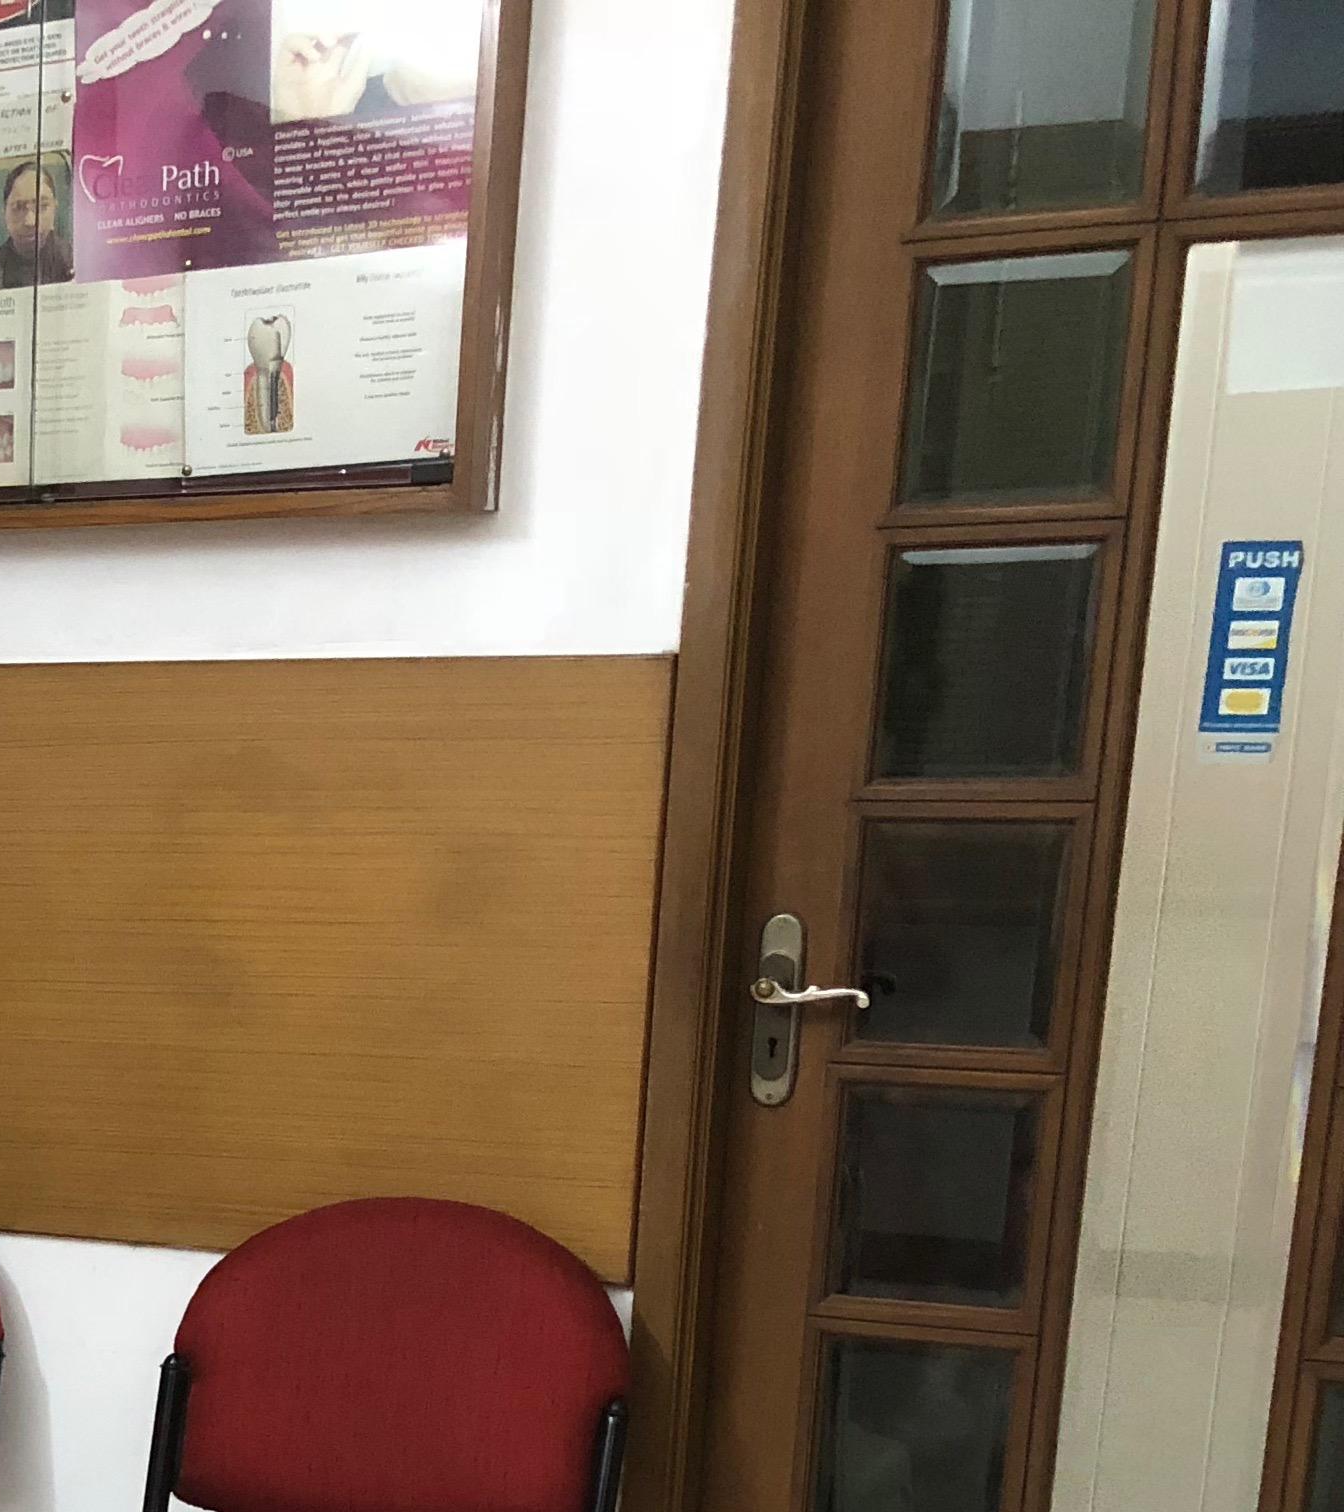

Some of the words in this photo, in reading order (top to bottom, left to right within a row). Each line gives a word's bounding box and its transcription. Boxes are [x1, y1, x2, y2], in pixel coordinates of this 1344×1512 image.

[97, 216, 124, 230] CLEAR
[125, 213, 165, 227] ALIGNERS
[174, 210, 188, 221] NO
[189, 206, 222, 220] BRACES
[1228, 550, 1300, 569] PUSH
[1229, 661, 1271, 676] VISA
